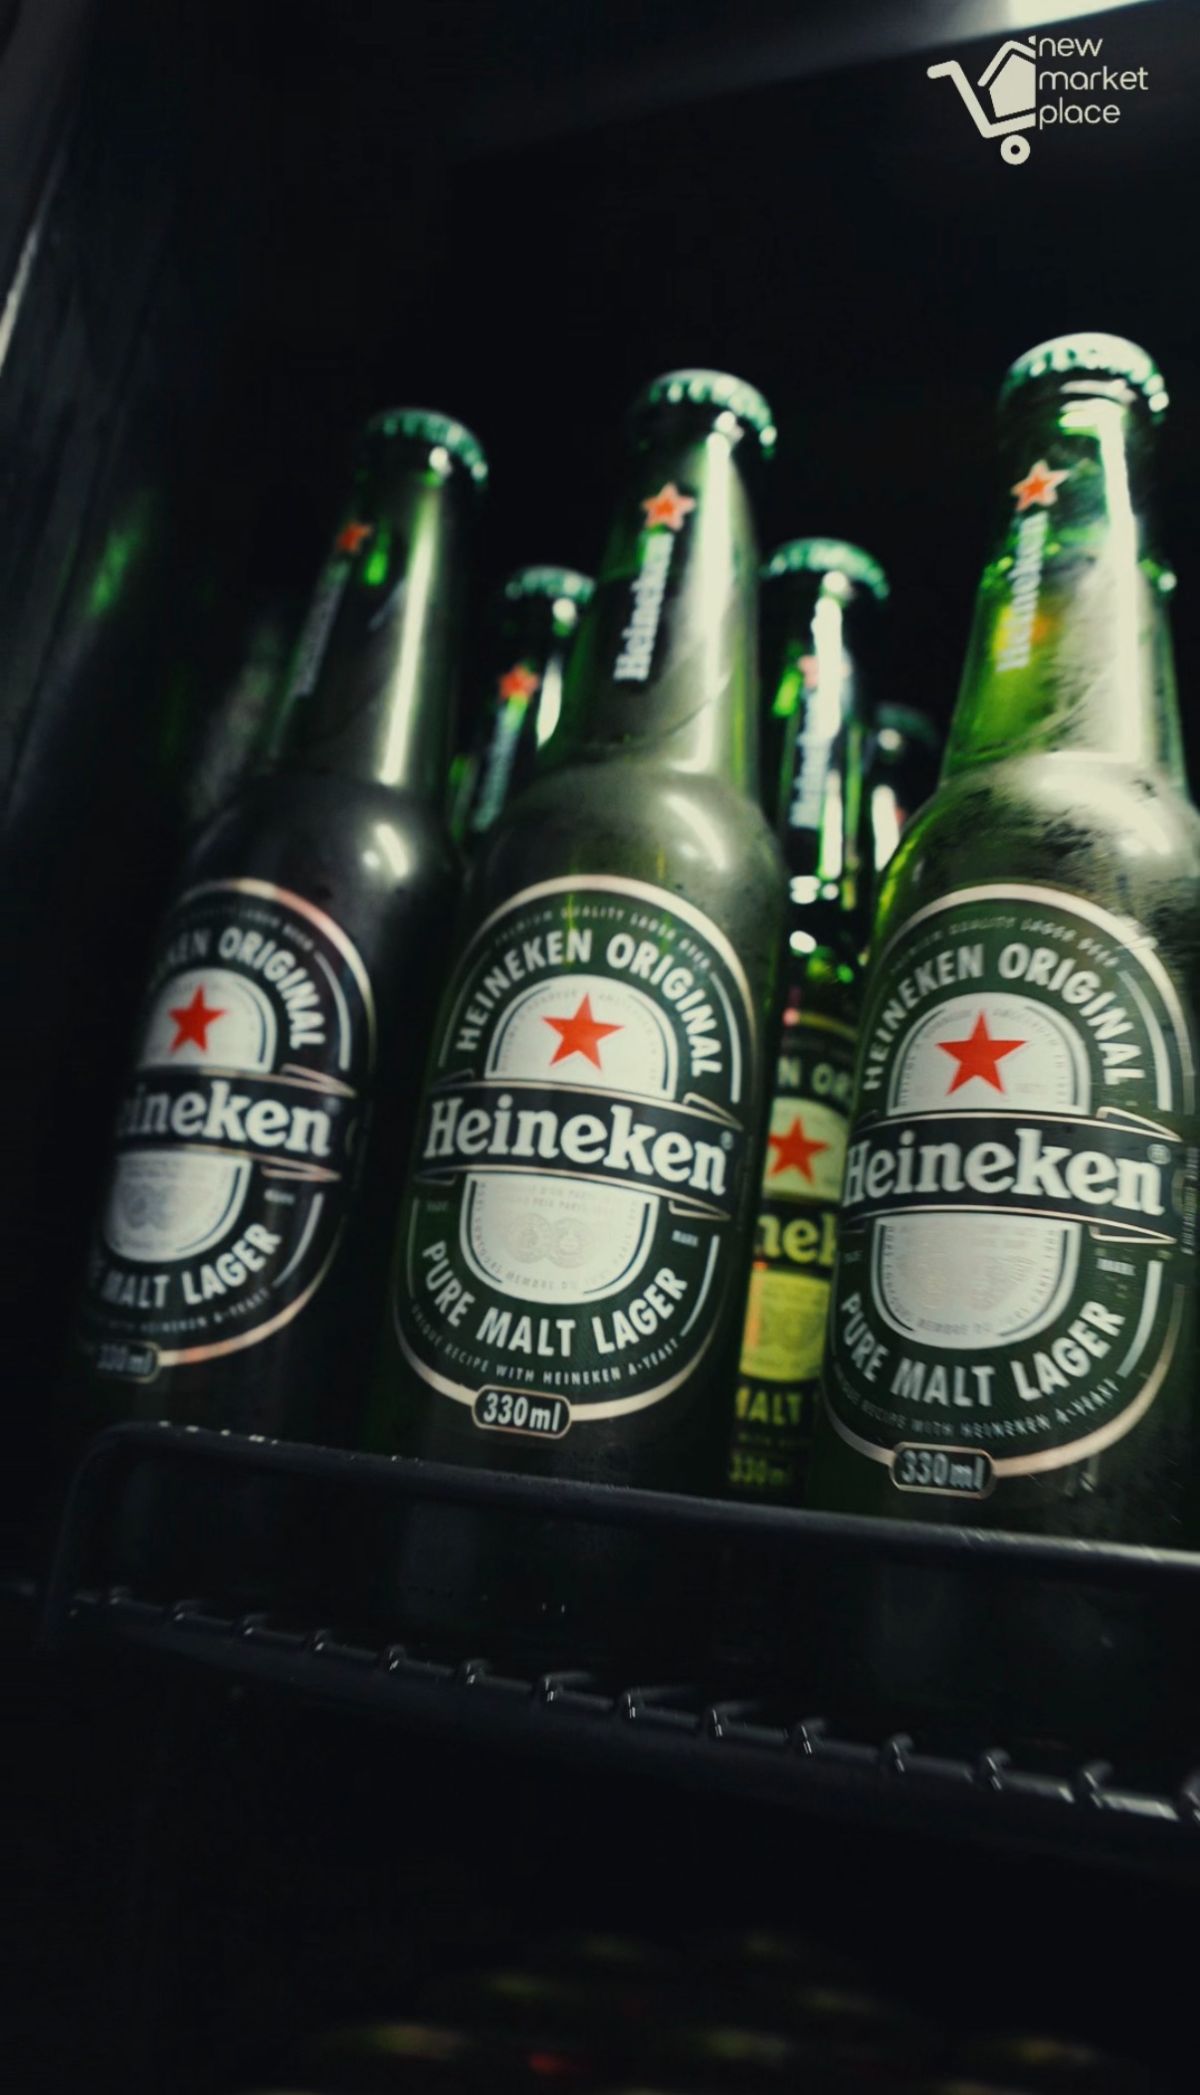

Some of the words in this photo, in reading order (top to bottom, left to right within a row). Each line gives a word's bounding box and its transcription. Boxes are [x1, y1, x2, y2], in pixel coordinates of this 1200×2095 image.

[218, 926, 326, 1050] ORIGINAL
[456, 928, 593, 1051] HEINEKEN
[605, 932, 722, 1078] ORIGINAL
[862, 943, 985, 1091] HEINEKEN
[999, 942, 1146, 1086] ORIGINAL
[422, 1094, 727, 1196] Heineken
[841, 1127, 1166, 1216] Heineken
[182, 1223, 282, 1305] LAGER
[422, 1240, 476, 1328] PURE
[475, 1306, 577, 1358] MALT
[591, 1266, 688, 1354] LAGER
[495, 1364, 535, 1383] WITH
[543, 1367, 622, 1396] HEINEKEN
[841, 1293, 889, 1383] PURE
[889, 1356, 996, 1407] MALT
[1009, 1300, 1126, 1402] LAGER
[482, 1391, 562, 1433] 330ml
[900, 1449, 985, 1491] 330ml
